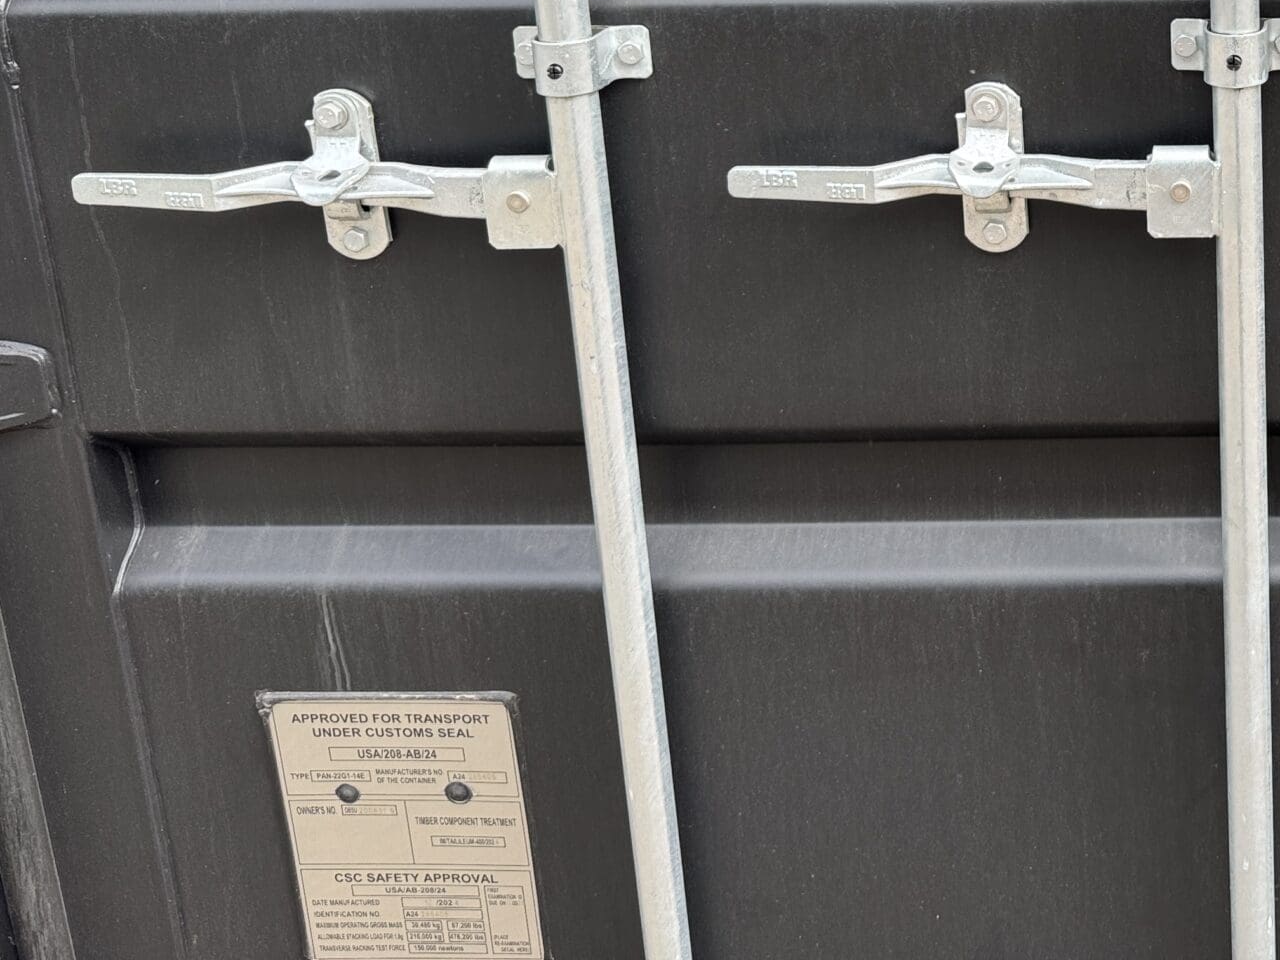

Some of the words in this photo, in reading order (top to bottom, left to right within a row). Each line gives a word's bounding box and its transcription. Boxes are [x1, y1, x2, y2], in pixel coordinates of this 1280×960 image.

[291, 714, 368, 724] APPROVED
[372, 714, 400, 723] FOR
[404, 714, 490, 725] TRANSPORT
[312, 728, 361, 738] UNDER
[365, 727, 433, 738] CUSTOMS
[438, 728, 474, 738] SEAL
[290, 772, 309, 780] TYPE
[296, 806, 325, 815] OWNER'S
[415, 817, 438, 826] TIMBER
[439, 817, 478, 826] COMPONENT
[480, 818, 516, 827] TREATMENT
[335, 873, 363, 883] CSC
[367, 873, 421, 883] SAFETY
[424, 873, 499, 884] APPROVAL
